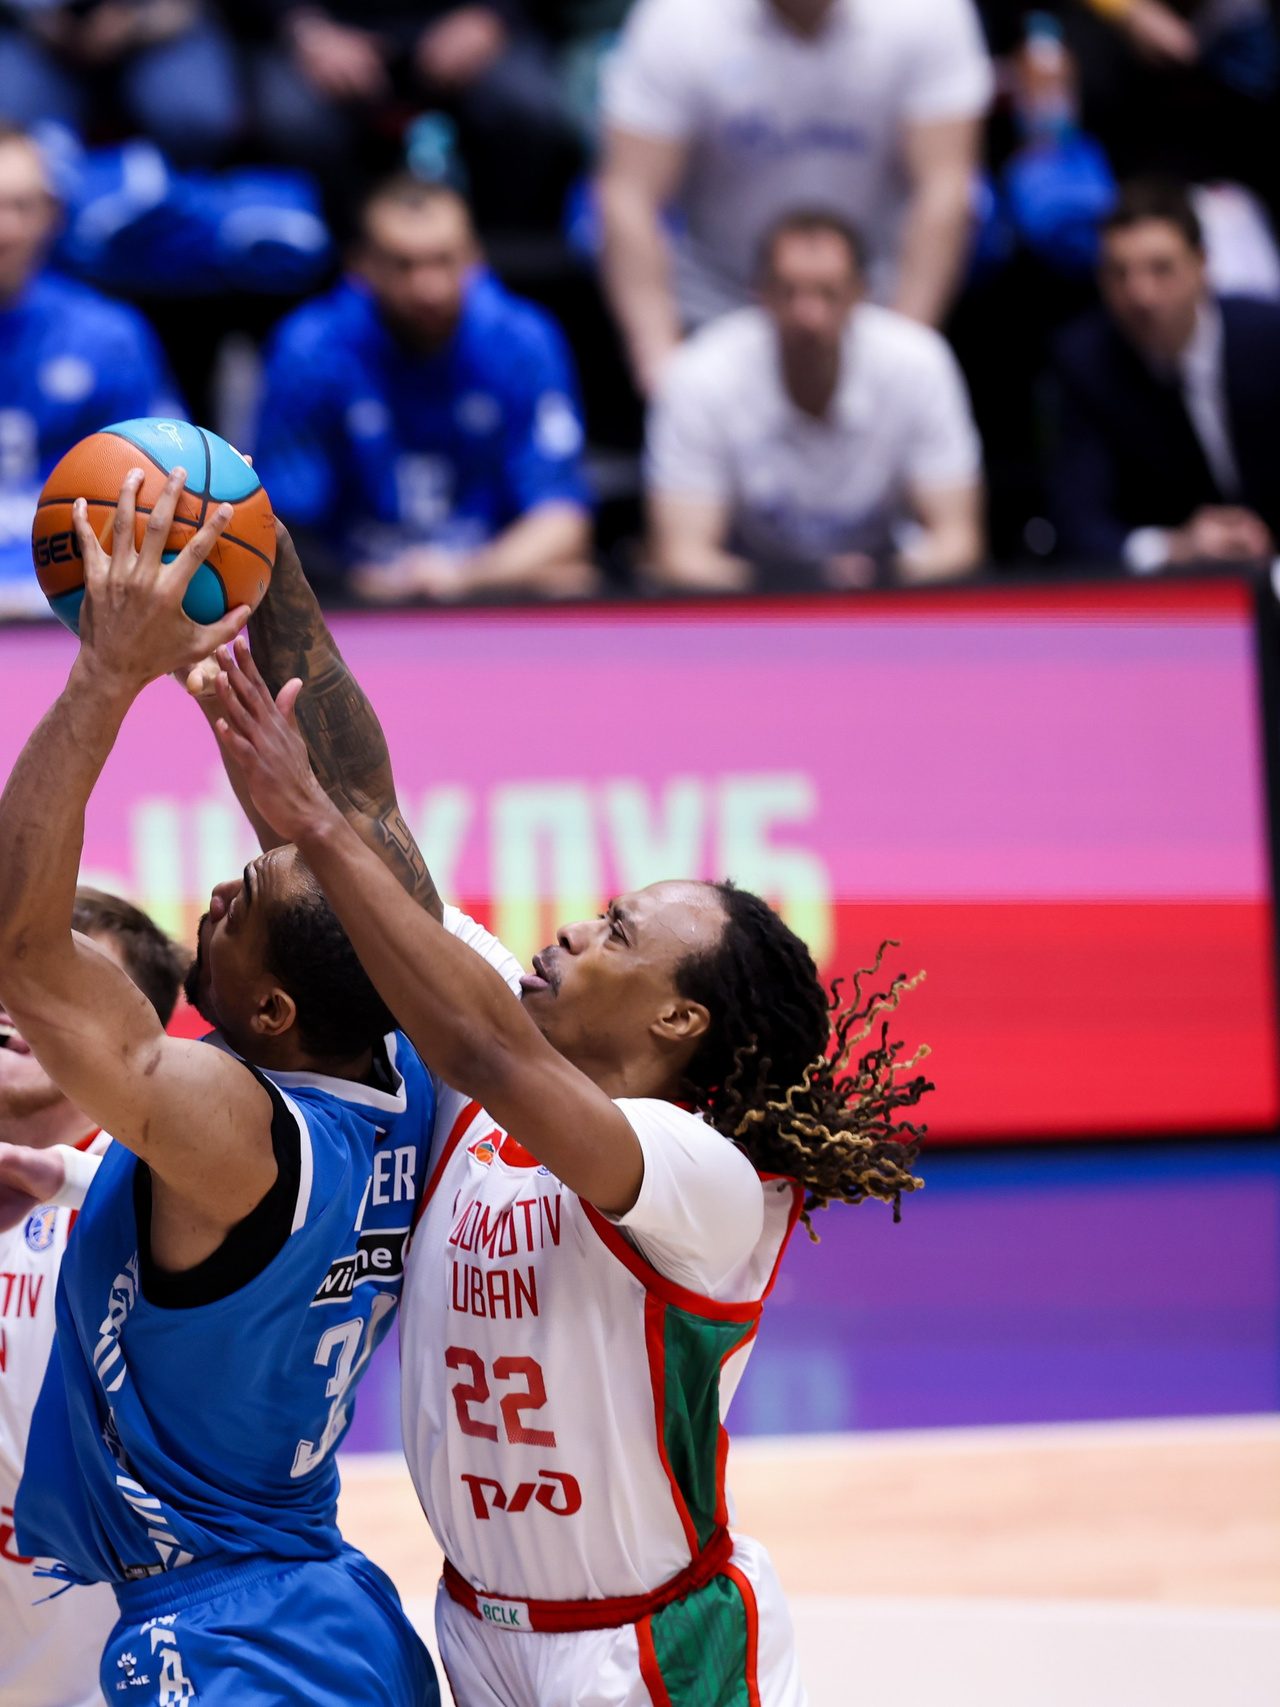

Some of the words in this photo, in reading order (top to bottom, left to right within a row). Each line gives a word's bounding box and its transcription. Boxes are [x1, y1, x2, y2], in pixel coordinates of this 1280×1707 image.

[452, 1261, 538, 1320] UBAN
[445, 1346, 557, 1449] 22
[482, 1603, 521, 1626] BCLK
